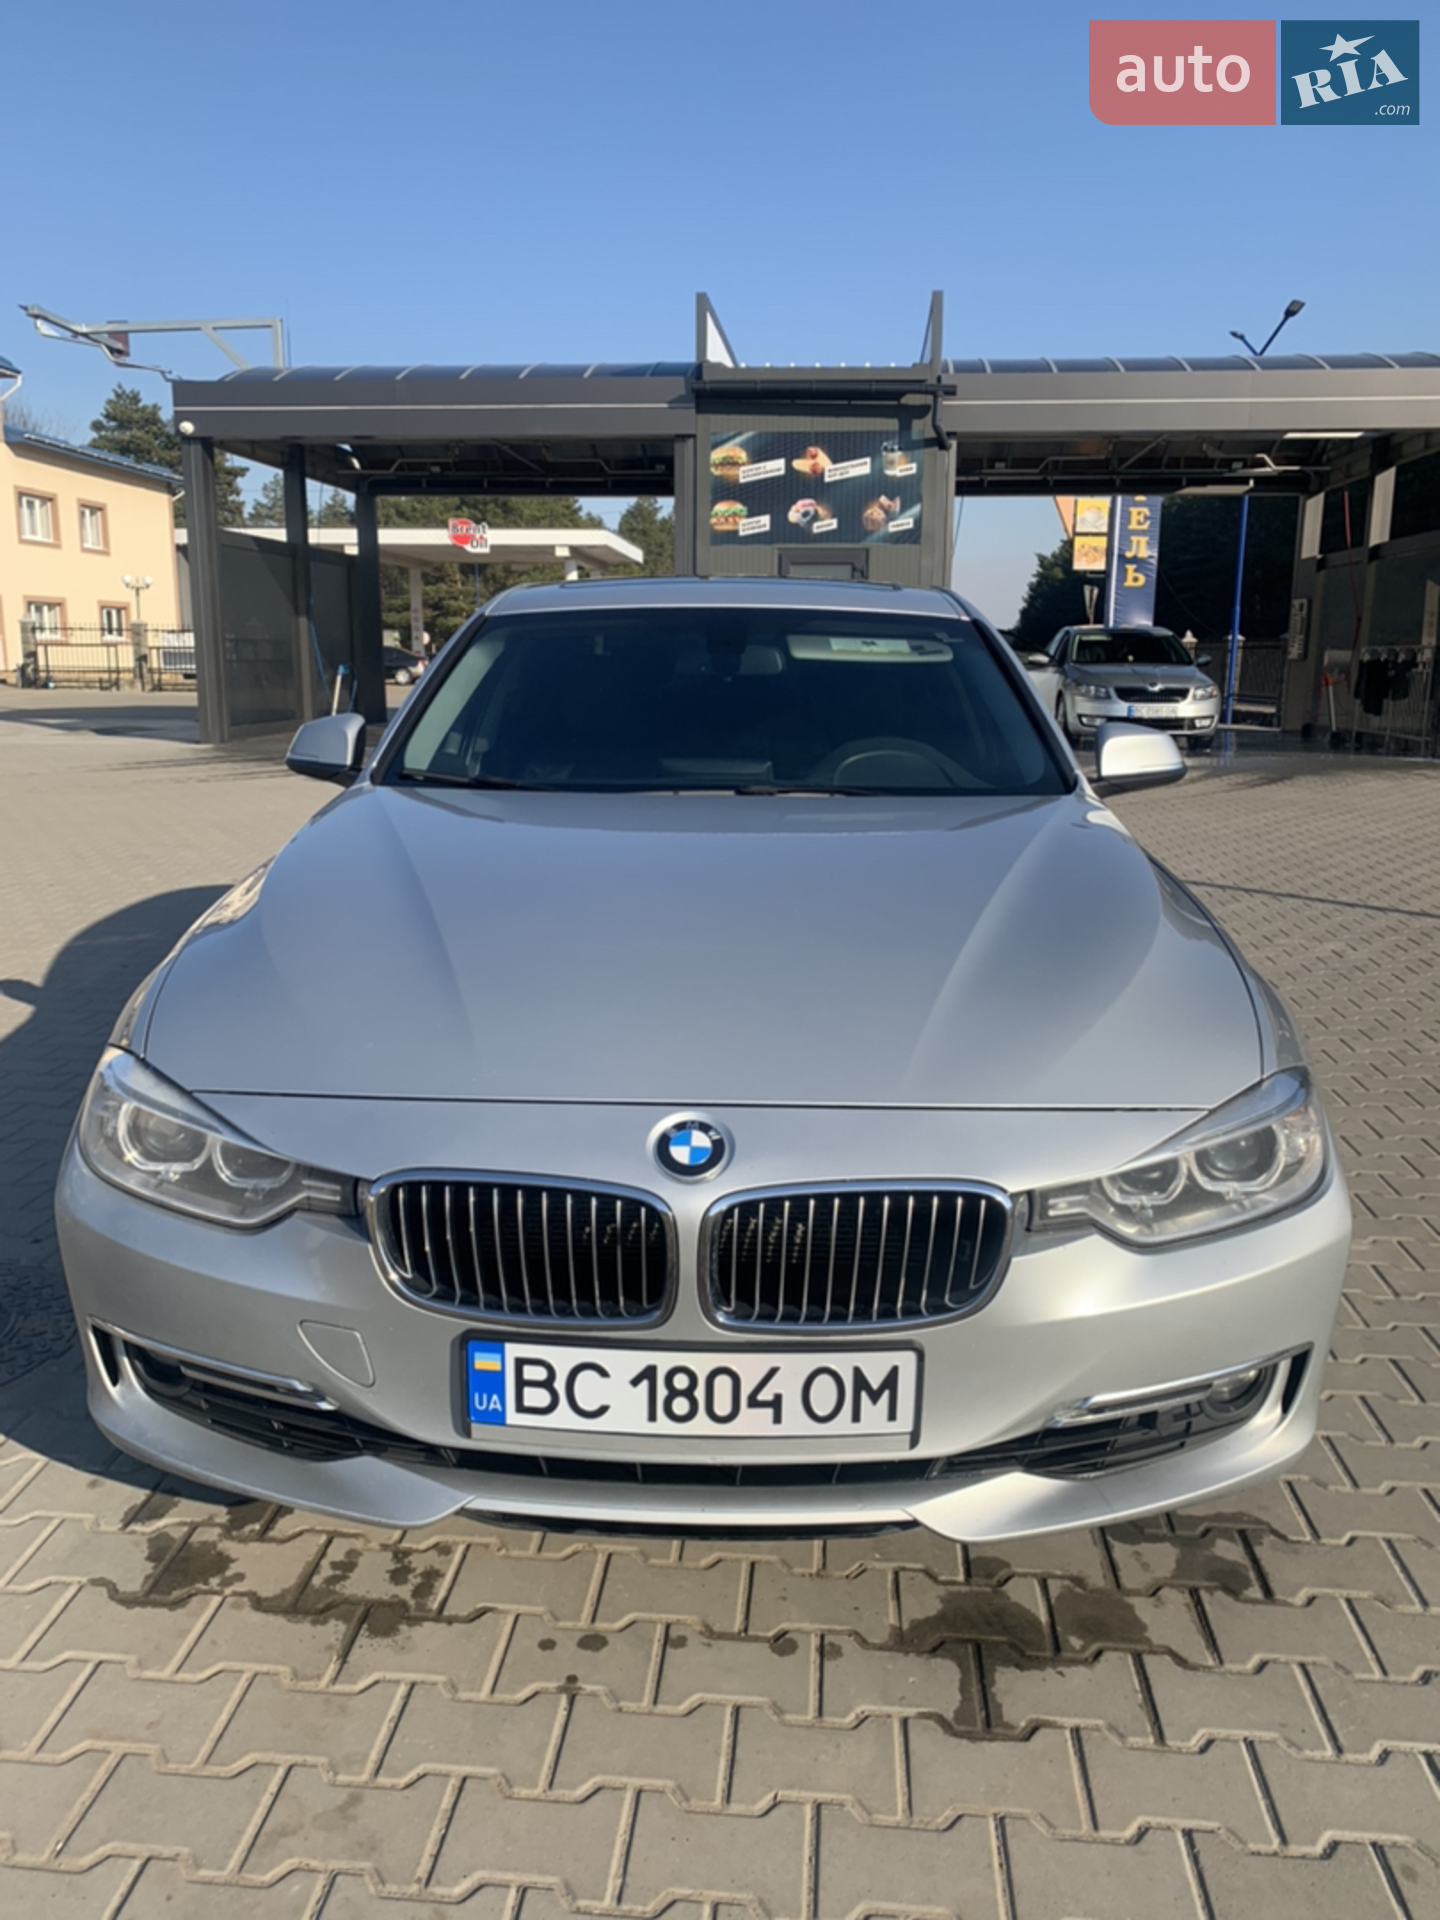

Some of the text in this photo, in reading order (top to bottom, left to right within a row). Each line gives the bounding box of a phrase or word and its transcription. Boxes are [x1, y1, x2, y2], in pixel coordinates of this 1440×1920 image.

[451, 522, 486, 535] Brent
[470, 535, 488, 549] Oil
[1123, 495, 1151, 587] ЕЛЬ
[514, 1356, 900, 1425] BC 1804 OM
[474, 1392, 502, 1412] UA
